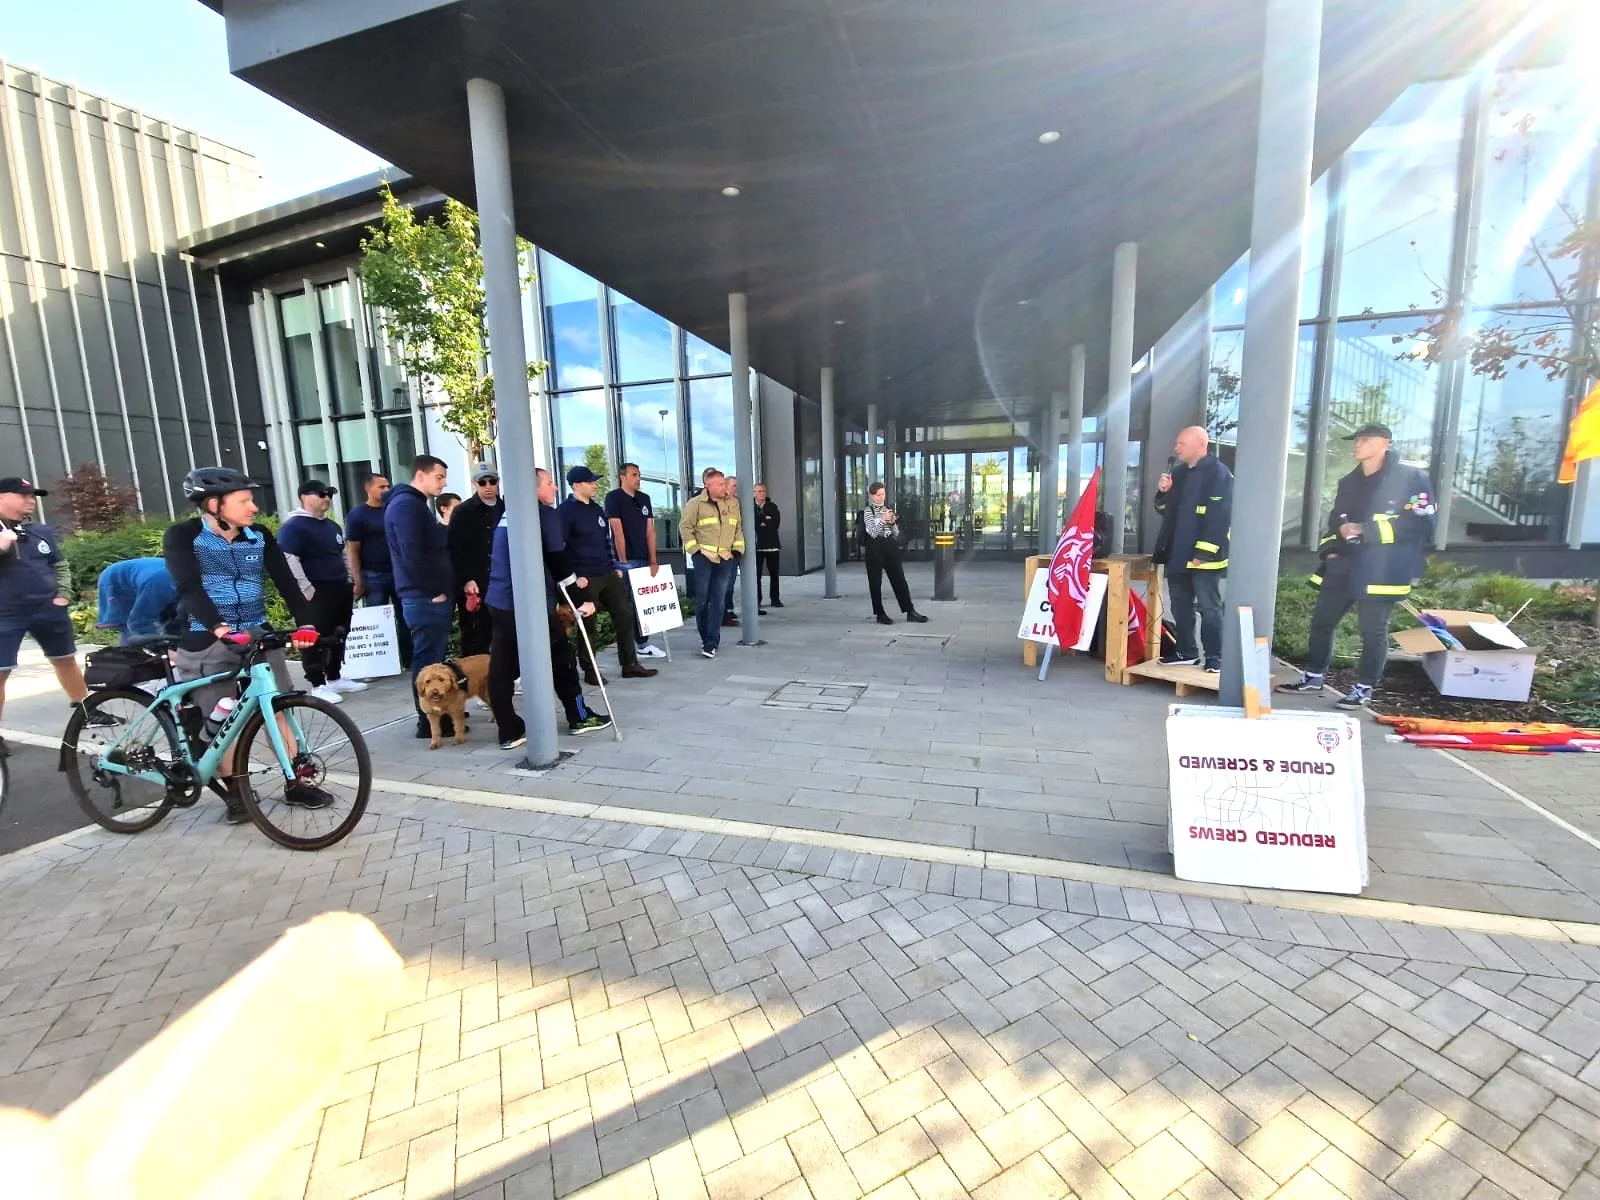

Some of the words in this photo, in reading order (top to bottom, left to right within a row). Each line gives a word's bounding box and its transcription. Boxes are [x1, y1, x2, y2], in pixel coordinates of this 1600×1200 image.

[637, 584, 660, 596] CREWS
[660, 582, 668, 591] OF
[669, 581, 674, 590] 3
[643, 606, 655, 616] NOT
[656, 604, 667, 612] FOR
[213, 694, 249, 749] TREK
[1179, 755, 1259, 771] SCREWED
[1262, 759, 1275, 772] &
[1280, 760, 1335, 775] CRUDE
[1188, 825, 1247, 843] CREWS
[1255, 830, 1336, 848] REDUCED
